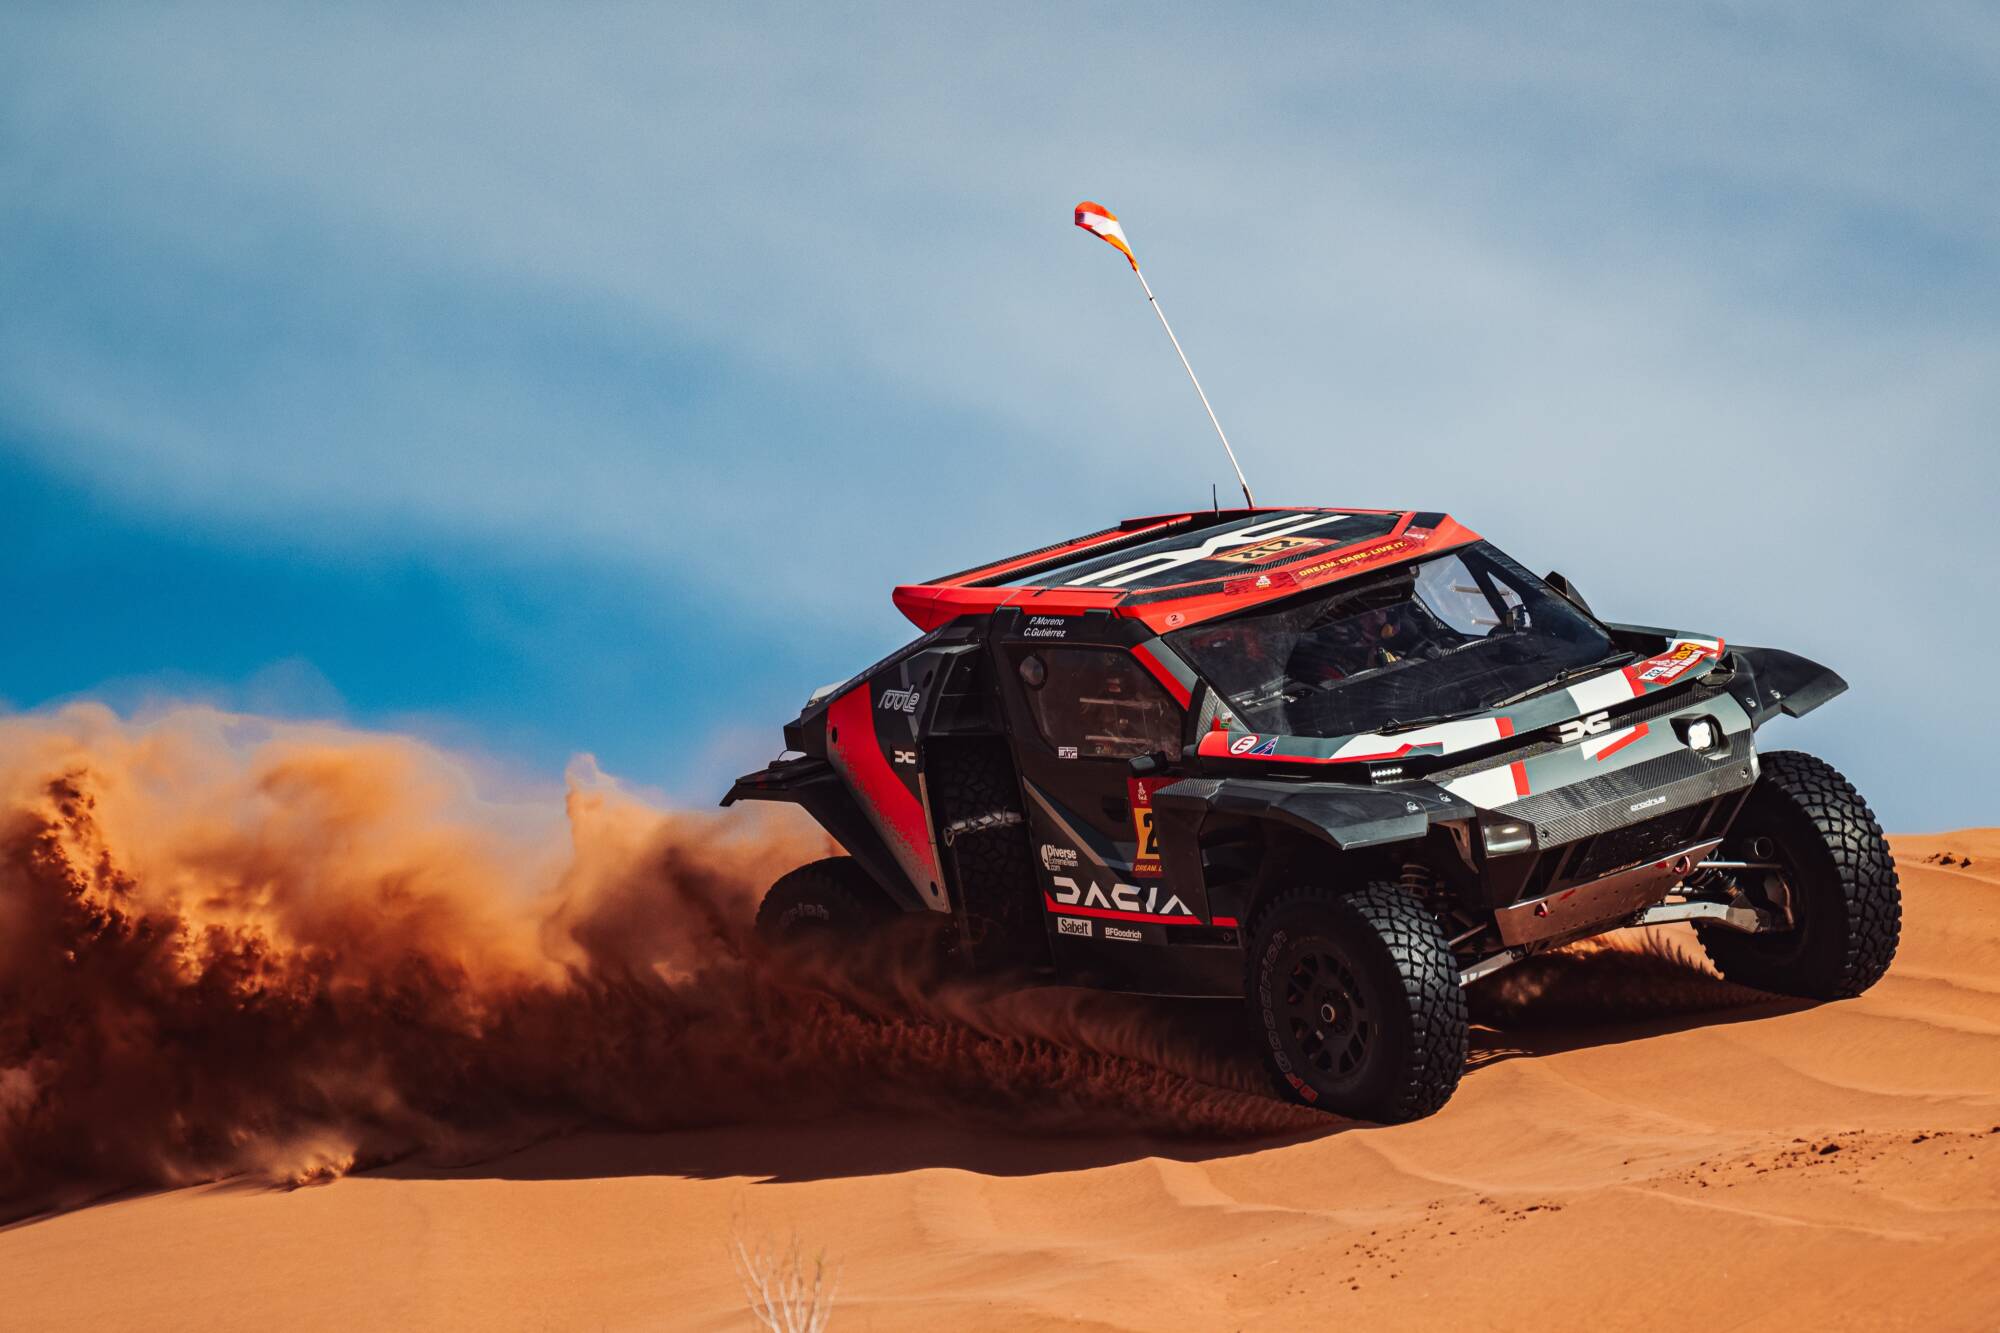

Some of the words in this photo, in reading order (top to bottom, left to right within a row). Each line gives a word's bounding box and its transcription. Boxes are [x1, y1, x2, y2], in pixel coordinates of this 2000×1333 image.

[1299, 561, 1339, 577] DREAM.
[1339, 552, 1371, 564] DARE.
[1371, 545, 1394, 555] LIVE
[1029, 616, 1065, 626] P.Moreno
[1023, 627, 1067, 638] C.Gutiérrez
[1233, 738, 1255, 751] E
[1047, 844, 1077, 859] Diverse
[1053, 876, 1193, 915] DACIA
[1061, 919, 1089, 935] Sabelt
[1105, 927, 1142, 940] BFGoodrich
